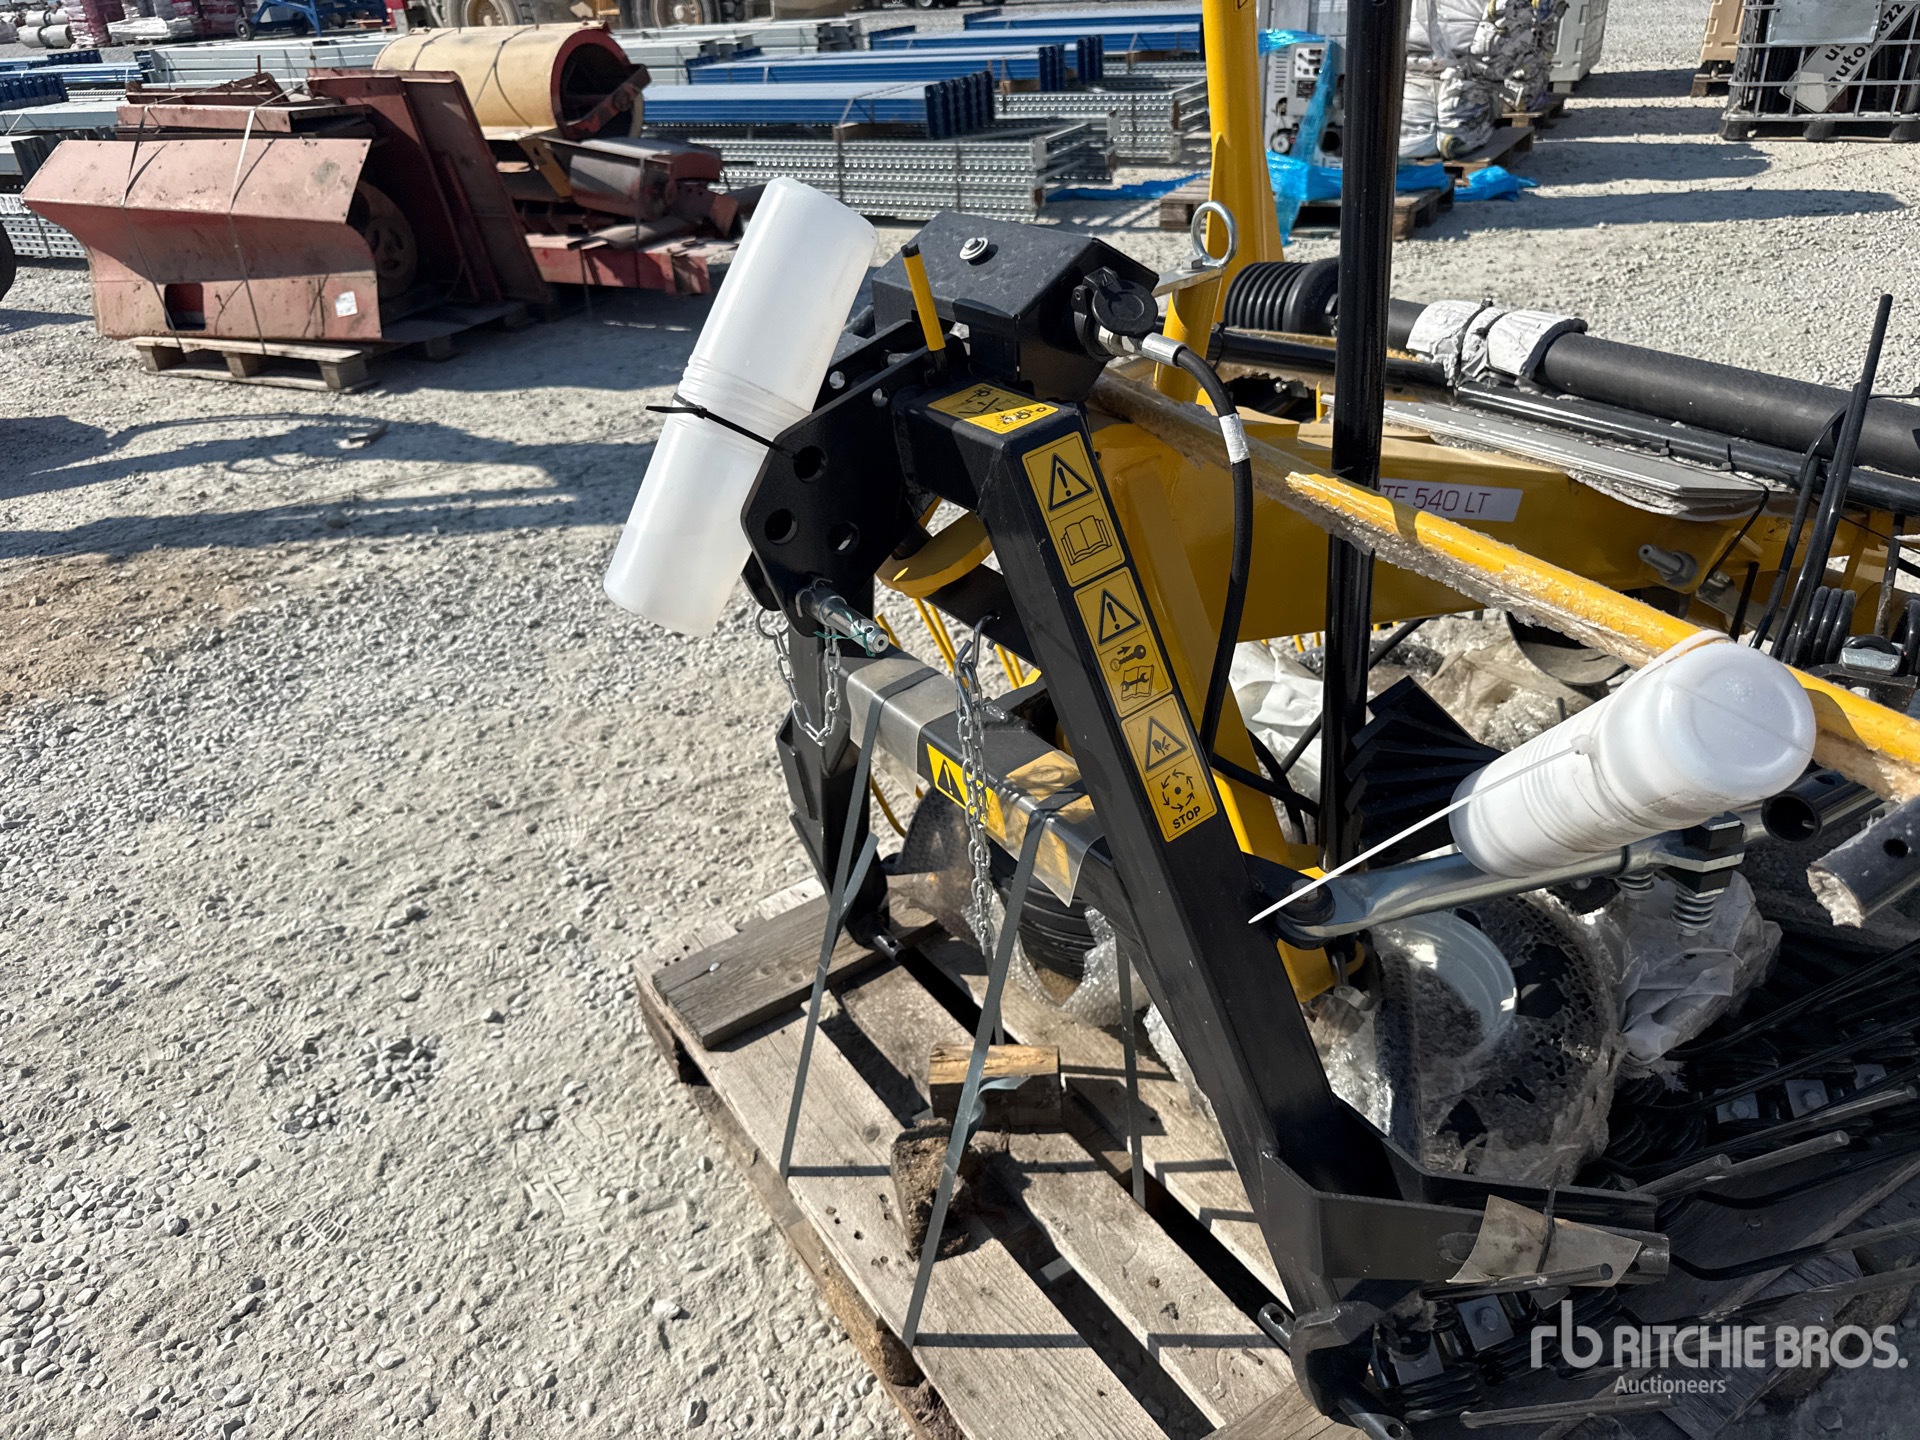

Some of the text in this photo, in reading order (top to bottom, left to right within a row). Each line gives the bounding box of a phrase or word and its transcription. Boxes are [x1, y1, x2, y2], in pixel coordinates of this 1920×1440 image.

[1413, 488, 1460, 512] 540
[1464, 492, 1491, 514] LT
[1172, 805, 1202, 829] STOP
